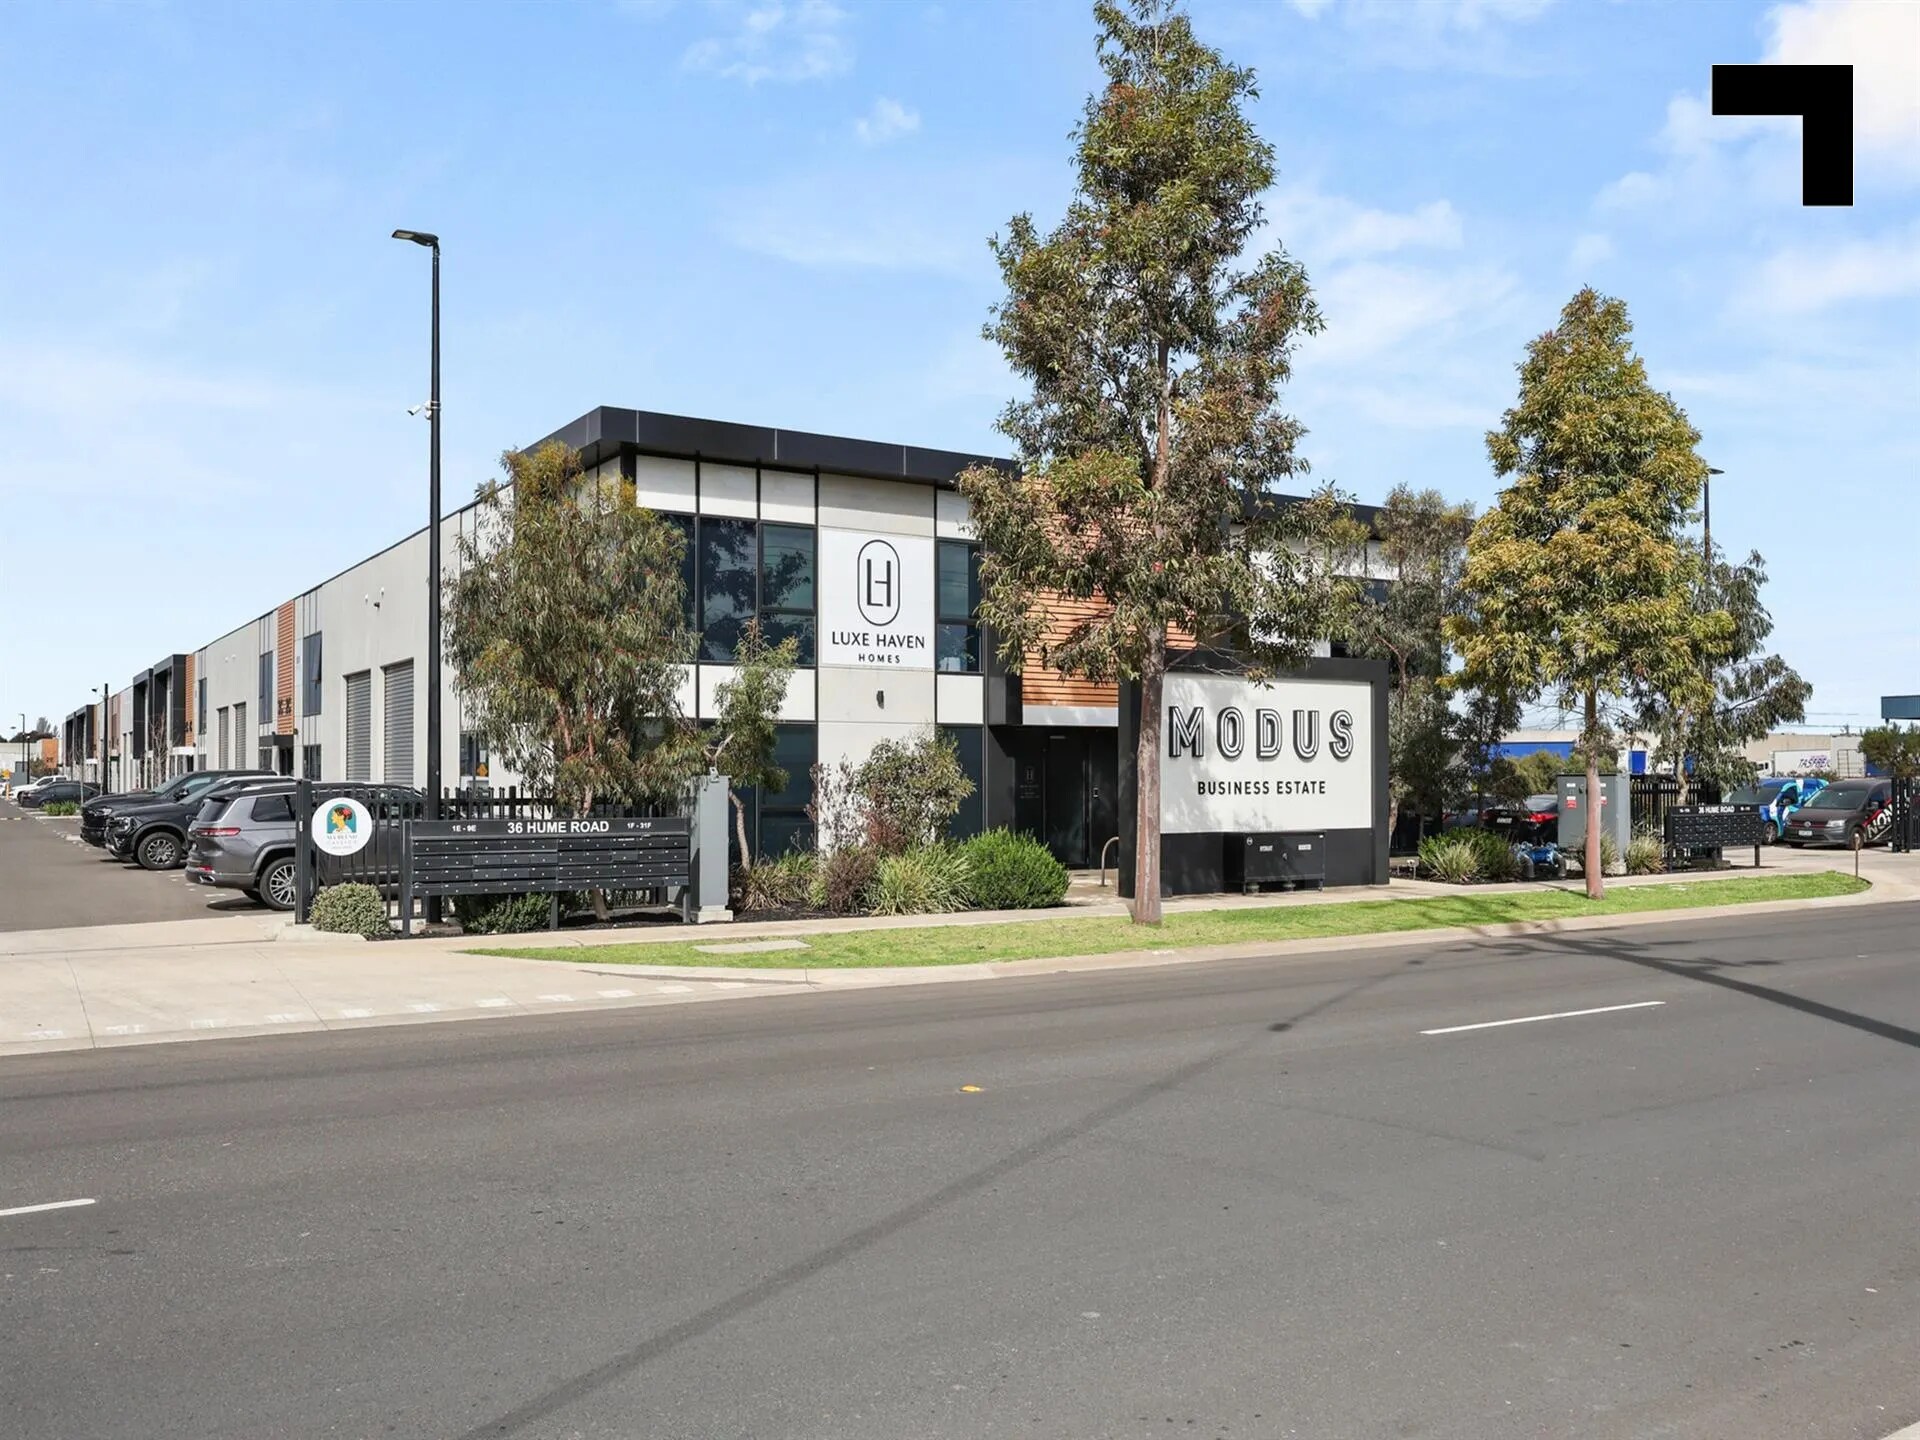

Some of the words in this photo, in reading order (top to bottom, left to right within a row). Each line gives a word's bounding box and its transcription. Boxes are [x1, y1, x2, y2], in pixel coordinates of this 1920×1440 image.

[832, 631, 870, 647] LUXE
[876, 634, 925, 649] HAVEN
[858, 653, 901, 664] HOMES
[1168, 706, 1354, 761] MODUS
[1197, 781, 1271, 795] BUSINESS
[1276, 780, 1327, 795] ESTATE
[452, 824, 461, 832] 1E
[507, 822, 523, 834] 36
[527, 821, 567, 834] HUME
[570, 820, 609, 833] ROAD
